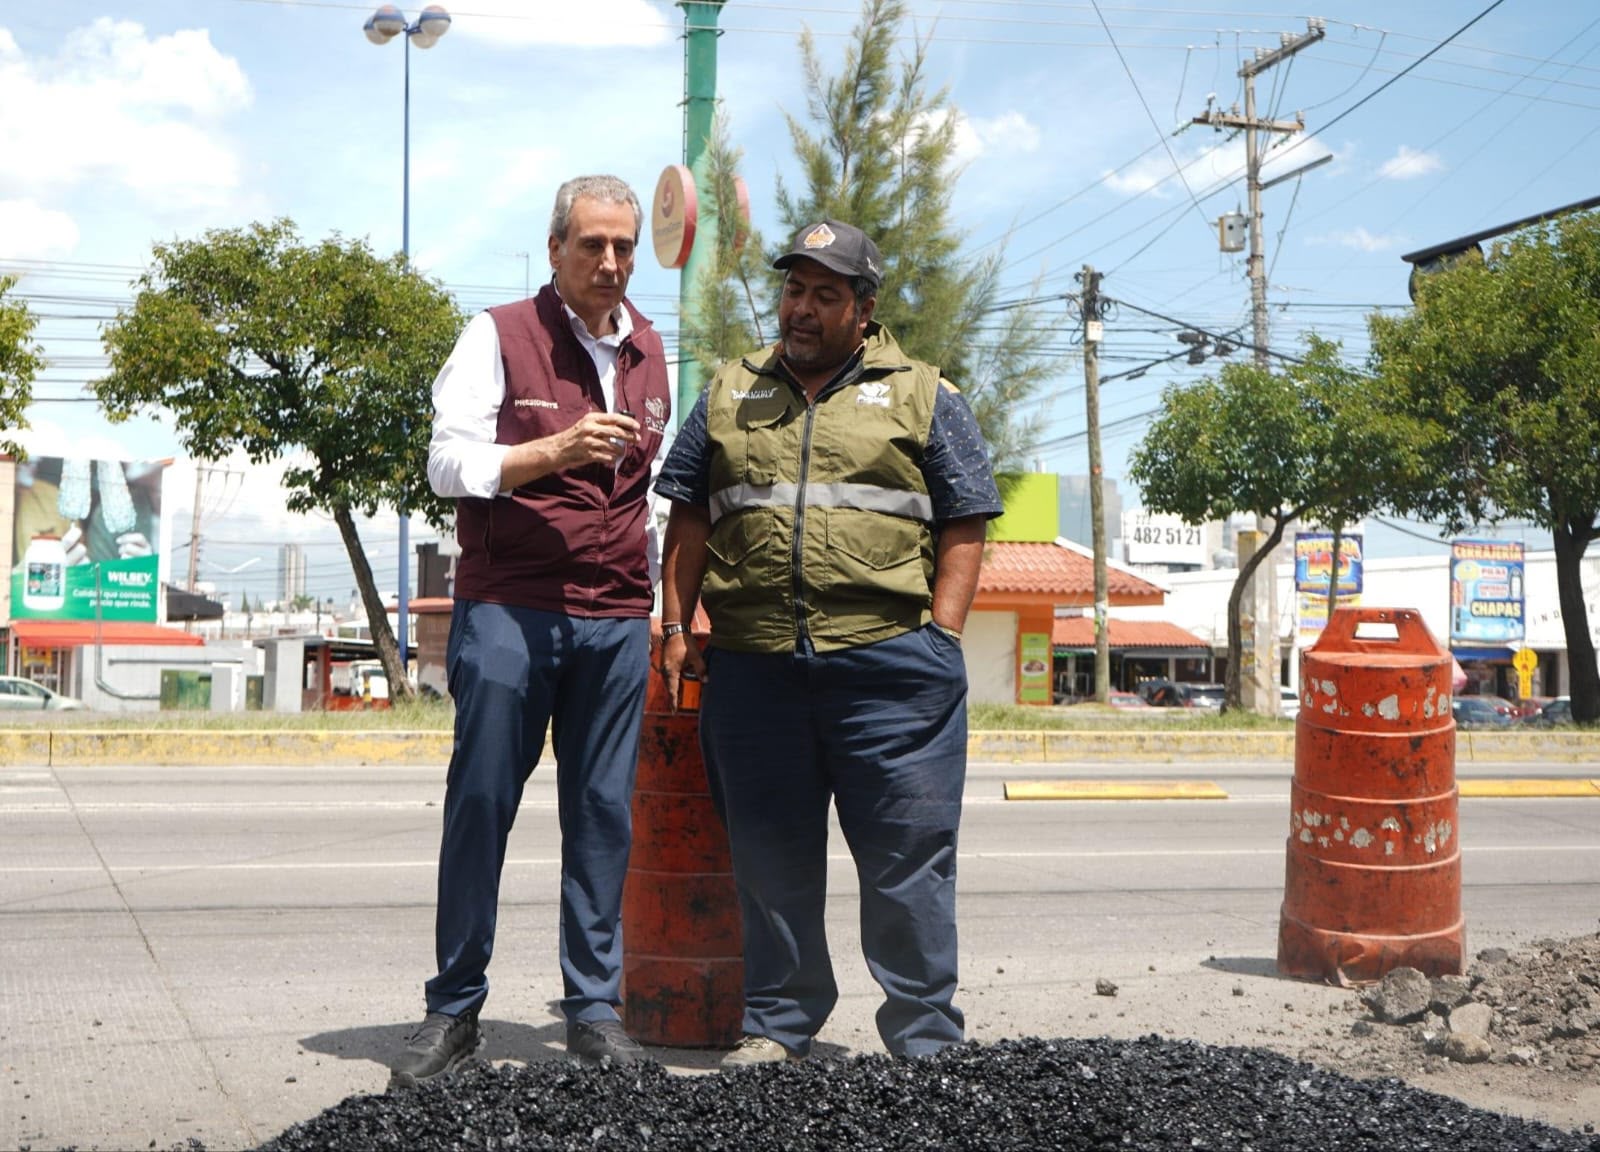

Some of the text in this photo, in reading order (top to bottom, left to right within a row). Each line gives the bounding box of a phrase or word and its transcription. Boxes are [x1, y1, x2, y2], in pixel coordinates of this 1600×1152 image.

[1133, 527, 1202, 546] 482 51 21
[1472, 601, 1521, 617] CHAPAS
